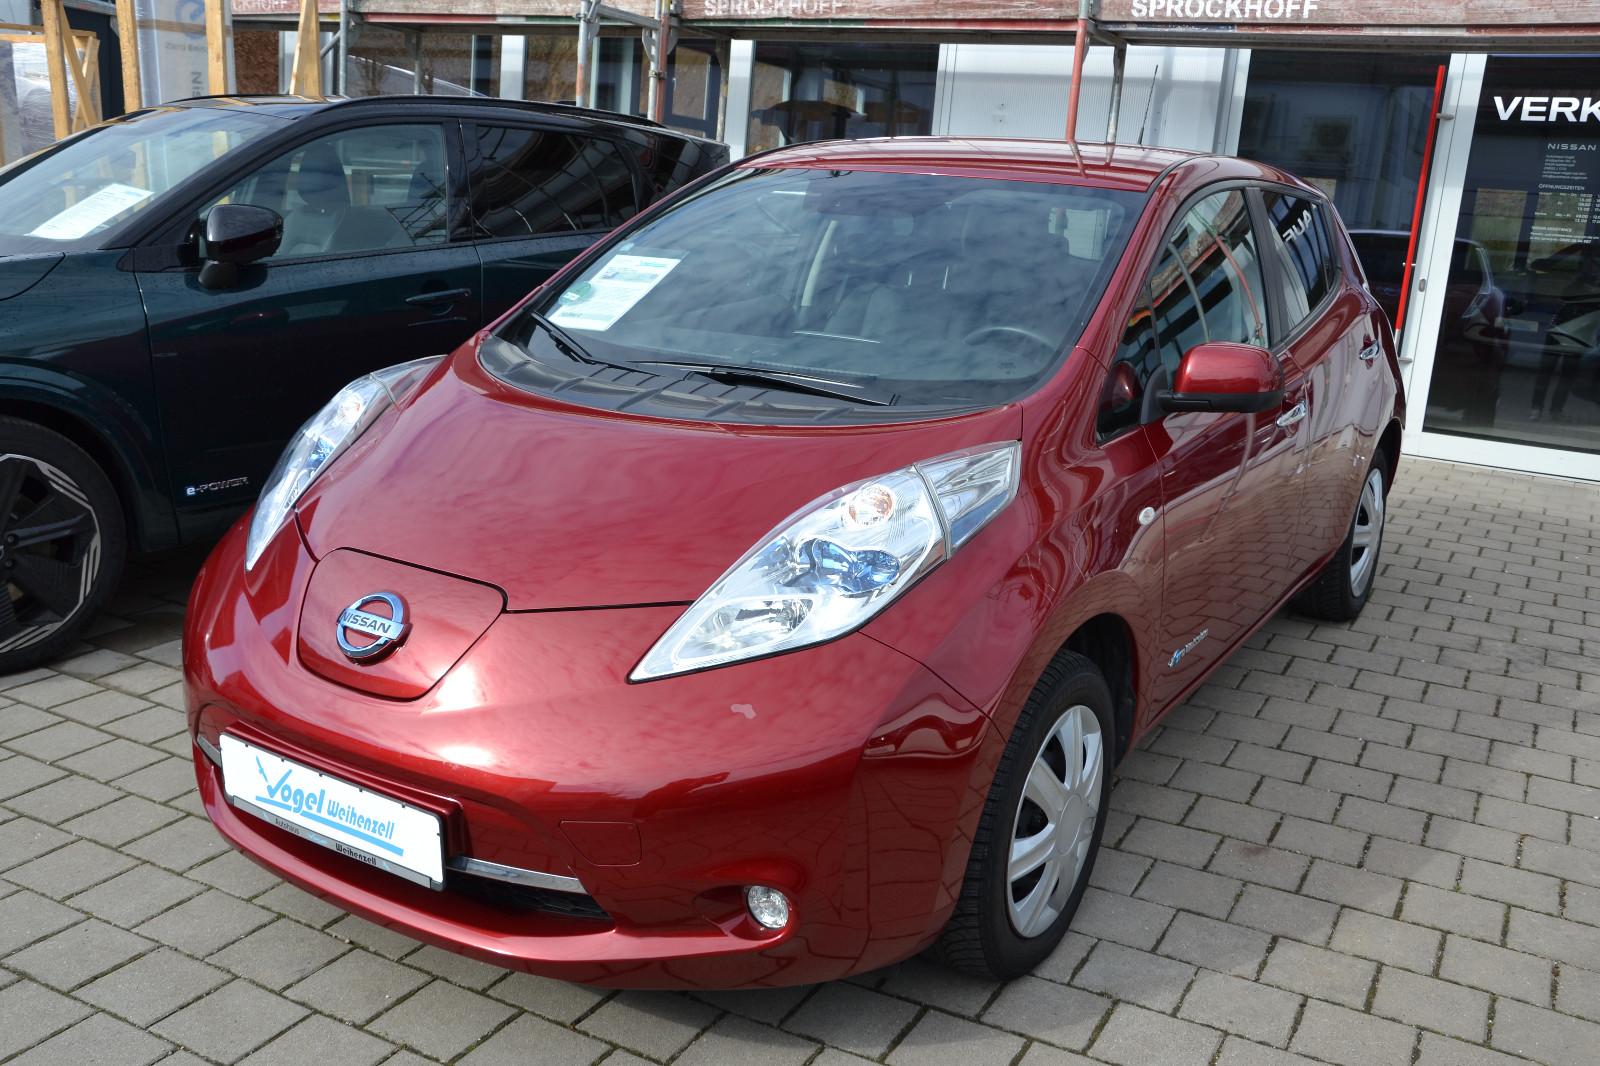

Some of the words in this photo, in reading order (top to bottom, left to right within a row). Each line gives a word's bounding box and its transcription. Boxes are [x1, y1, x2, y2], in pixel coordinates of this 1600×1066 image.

[1131, 0, 1319, 19] SPROCKHOFF
[1493, 96, 1600, 122] VERK
[1547, 143, 1597, 151] NISSAN
[341, 611, 392, 634] NISSAN
[256, 755, 326, 813] Vogel
[326, 799, 396, 840] Weihenzell
[335, 842, 377, 866] Weihenzell
